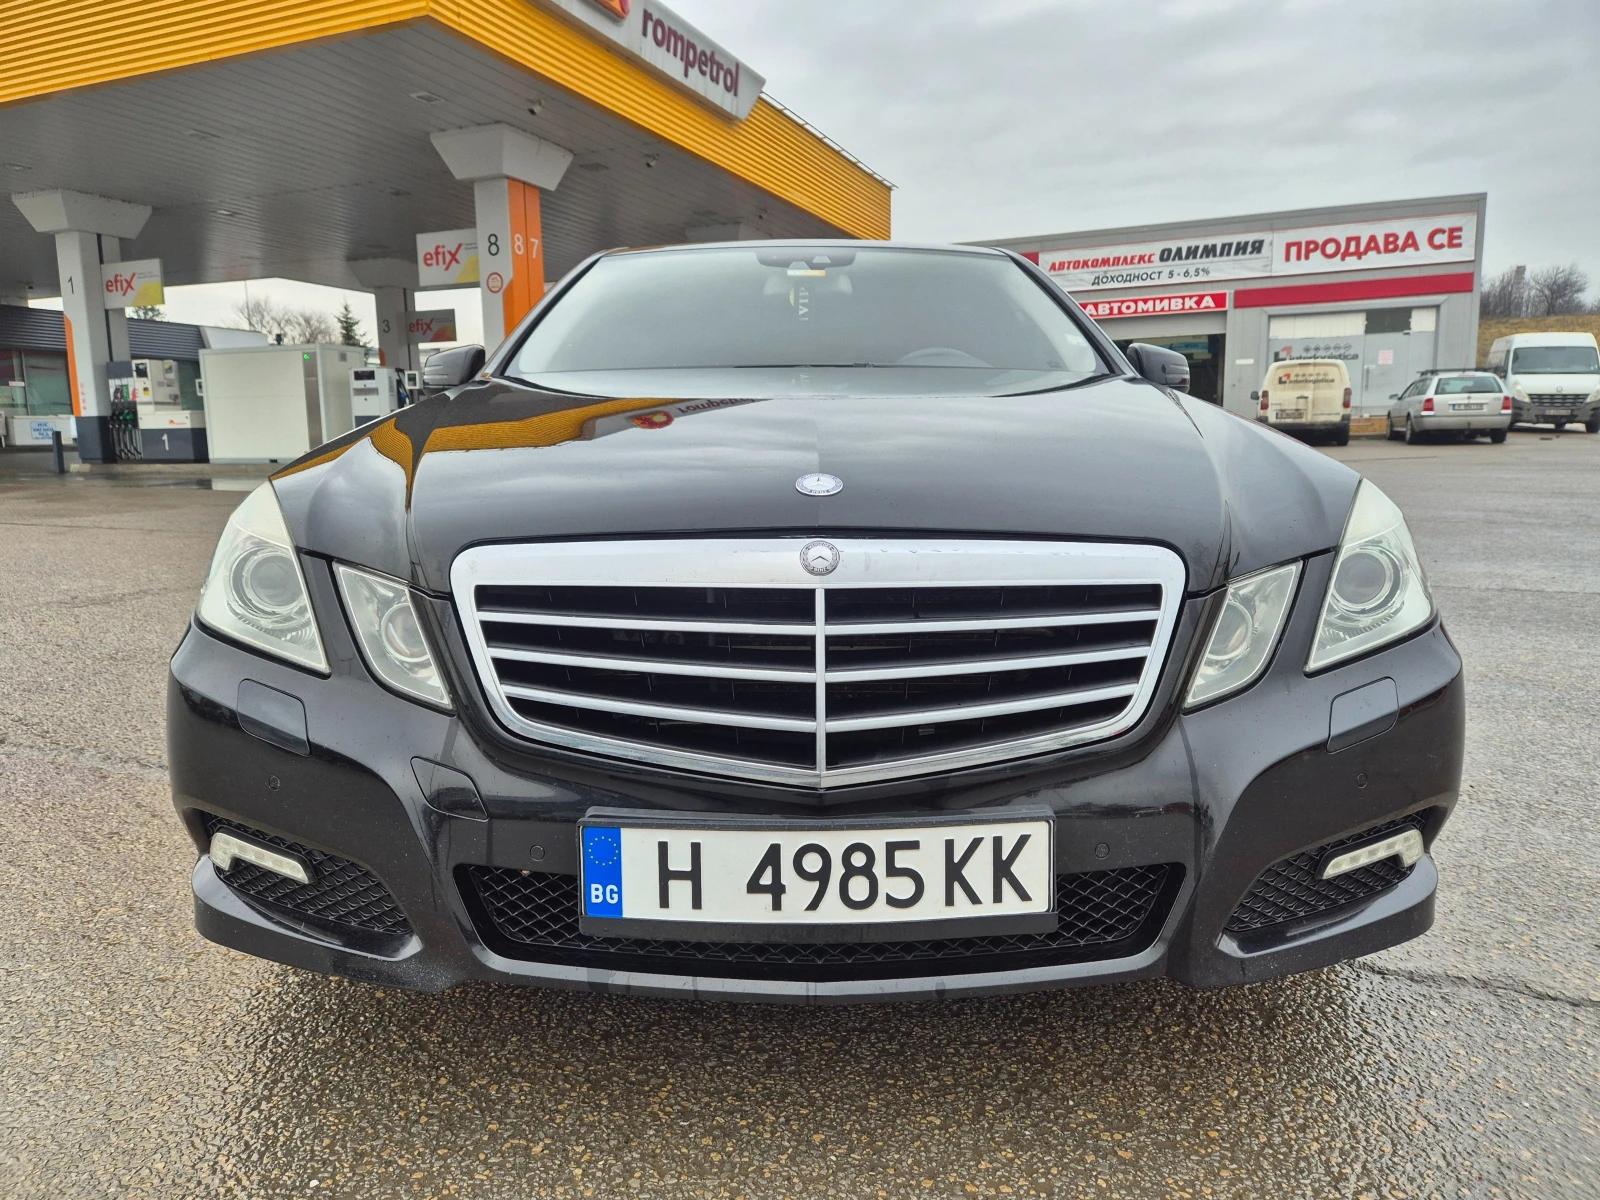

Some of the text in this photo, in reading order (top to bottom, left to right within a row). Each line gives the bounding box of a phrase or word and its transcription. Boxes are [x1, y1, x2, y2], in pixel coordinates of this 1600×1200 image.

[642, 8, 740, 97] rompetrol
[488, 233, 500, 256] 8
[514, 233, 525, 255] 8
[530, 238, 539, 258] 7
[1285, 227, 1463, 262] ПРОДАВА СЕ
[423, 243, 463, 271] efix
[1048, 239, 1265, 272] АВТОКОМПЛЕКС ОЛИМПИЯ
[67, 276, 75, 294] 1
[105, 272, 136, 296] efix
[1091, 270, 1163, 287] ДОХОДНОСТ
[1167, 269, 1175, 279] 5
[1183, 267, 1211, 279] 6,5%
[1084, 294, 1216, 316] АВТОМИВКА
[382, 319, 391, 333] 3
[408, 318, 434, 336] efix
[161, 433, 169, 451] 1
[657, 834, 1032, 911] H 4985 KK
[590, 883, 619, 904] BG
